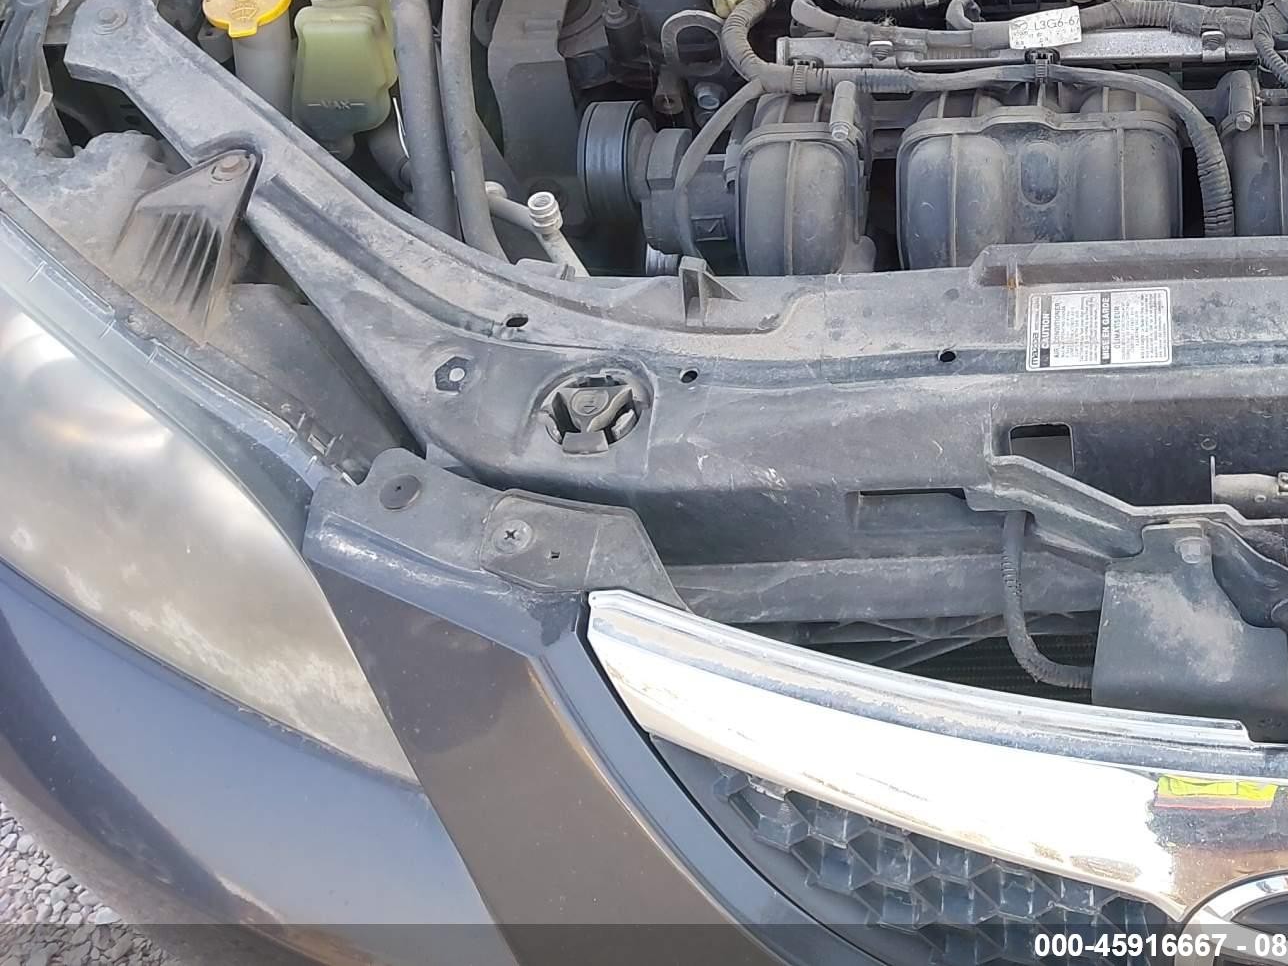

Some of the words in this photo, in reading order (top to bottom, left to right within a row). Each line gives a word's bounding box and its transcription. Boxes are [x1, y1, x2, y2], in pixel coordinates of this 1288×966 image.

[1101, 297, 1110, 325] GARDE
[1041, 313, 1050, 349] CAUTION
[1101, 326, 1110, 337] EN
[1113, 305, 1121, 350] CLIMATISEUR
[1101, 338, 1110, 360] MISE
